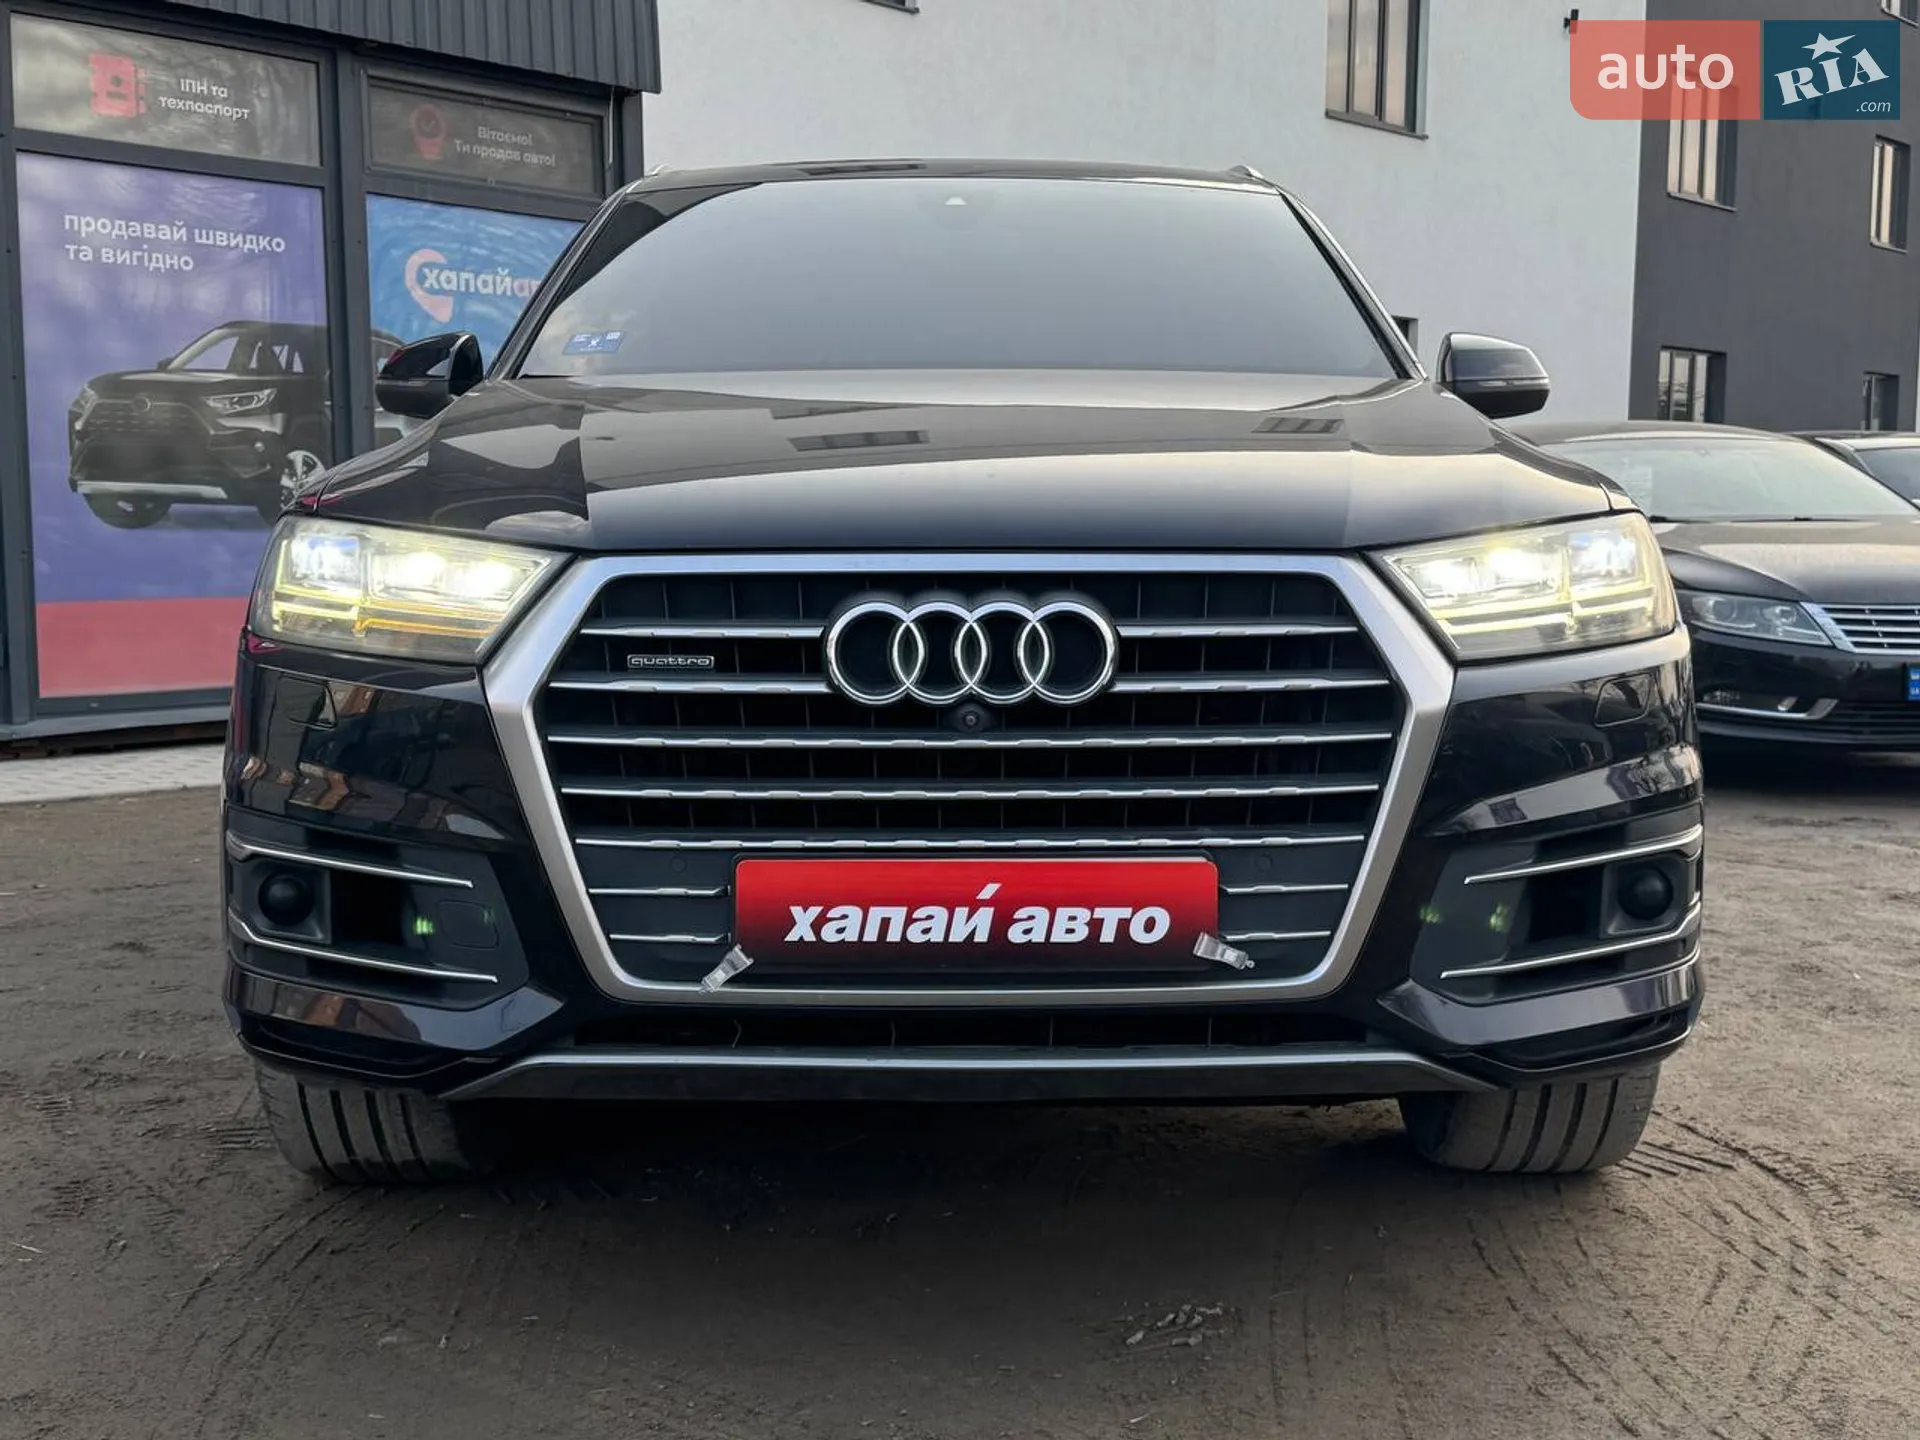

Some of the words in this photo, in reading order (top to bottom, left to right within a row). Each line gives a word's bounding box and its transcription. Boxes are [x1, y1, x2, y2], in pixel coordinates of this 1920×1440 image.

[211, 84, 228, 98] та
[158, 95, 250, 121] техпаспорт
[454, 138, 471, 154] Ти
[472, 144, 521, 162] продав
[63, 213, 187, 241] продавай
[194, 228, 286, 253] швидко
[65, 244, 93, 262] та
[101, 245, 194, 272] вигідно
[631, 656, 710, 666] quattro
[784, 883, 1002, 943] хапай
[1007, 905, 1170, 944] авто
